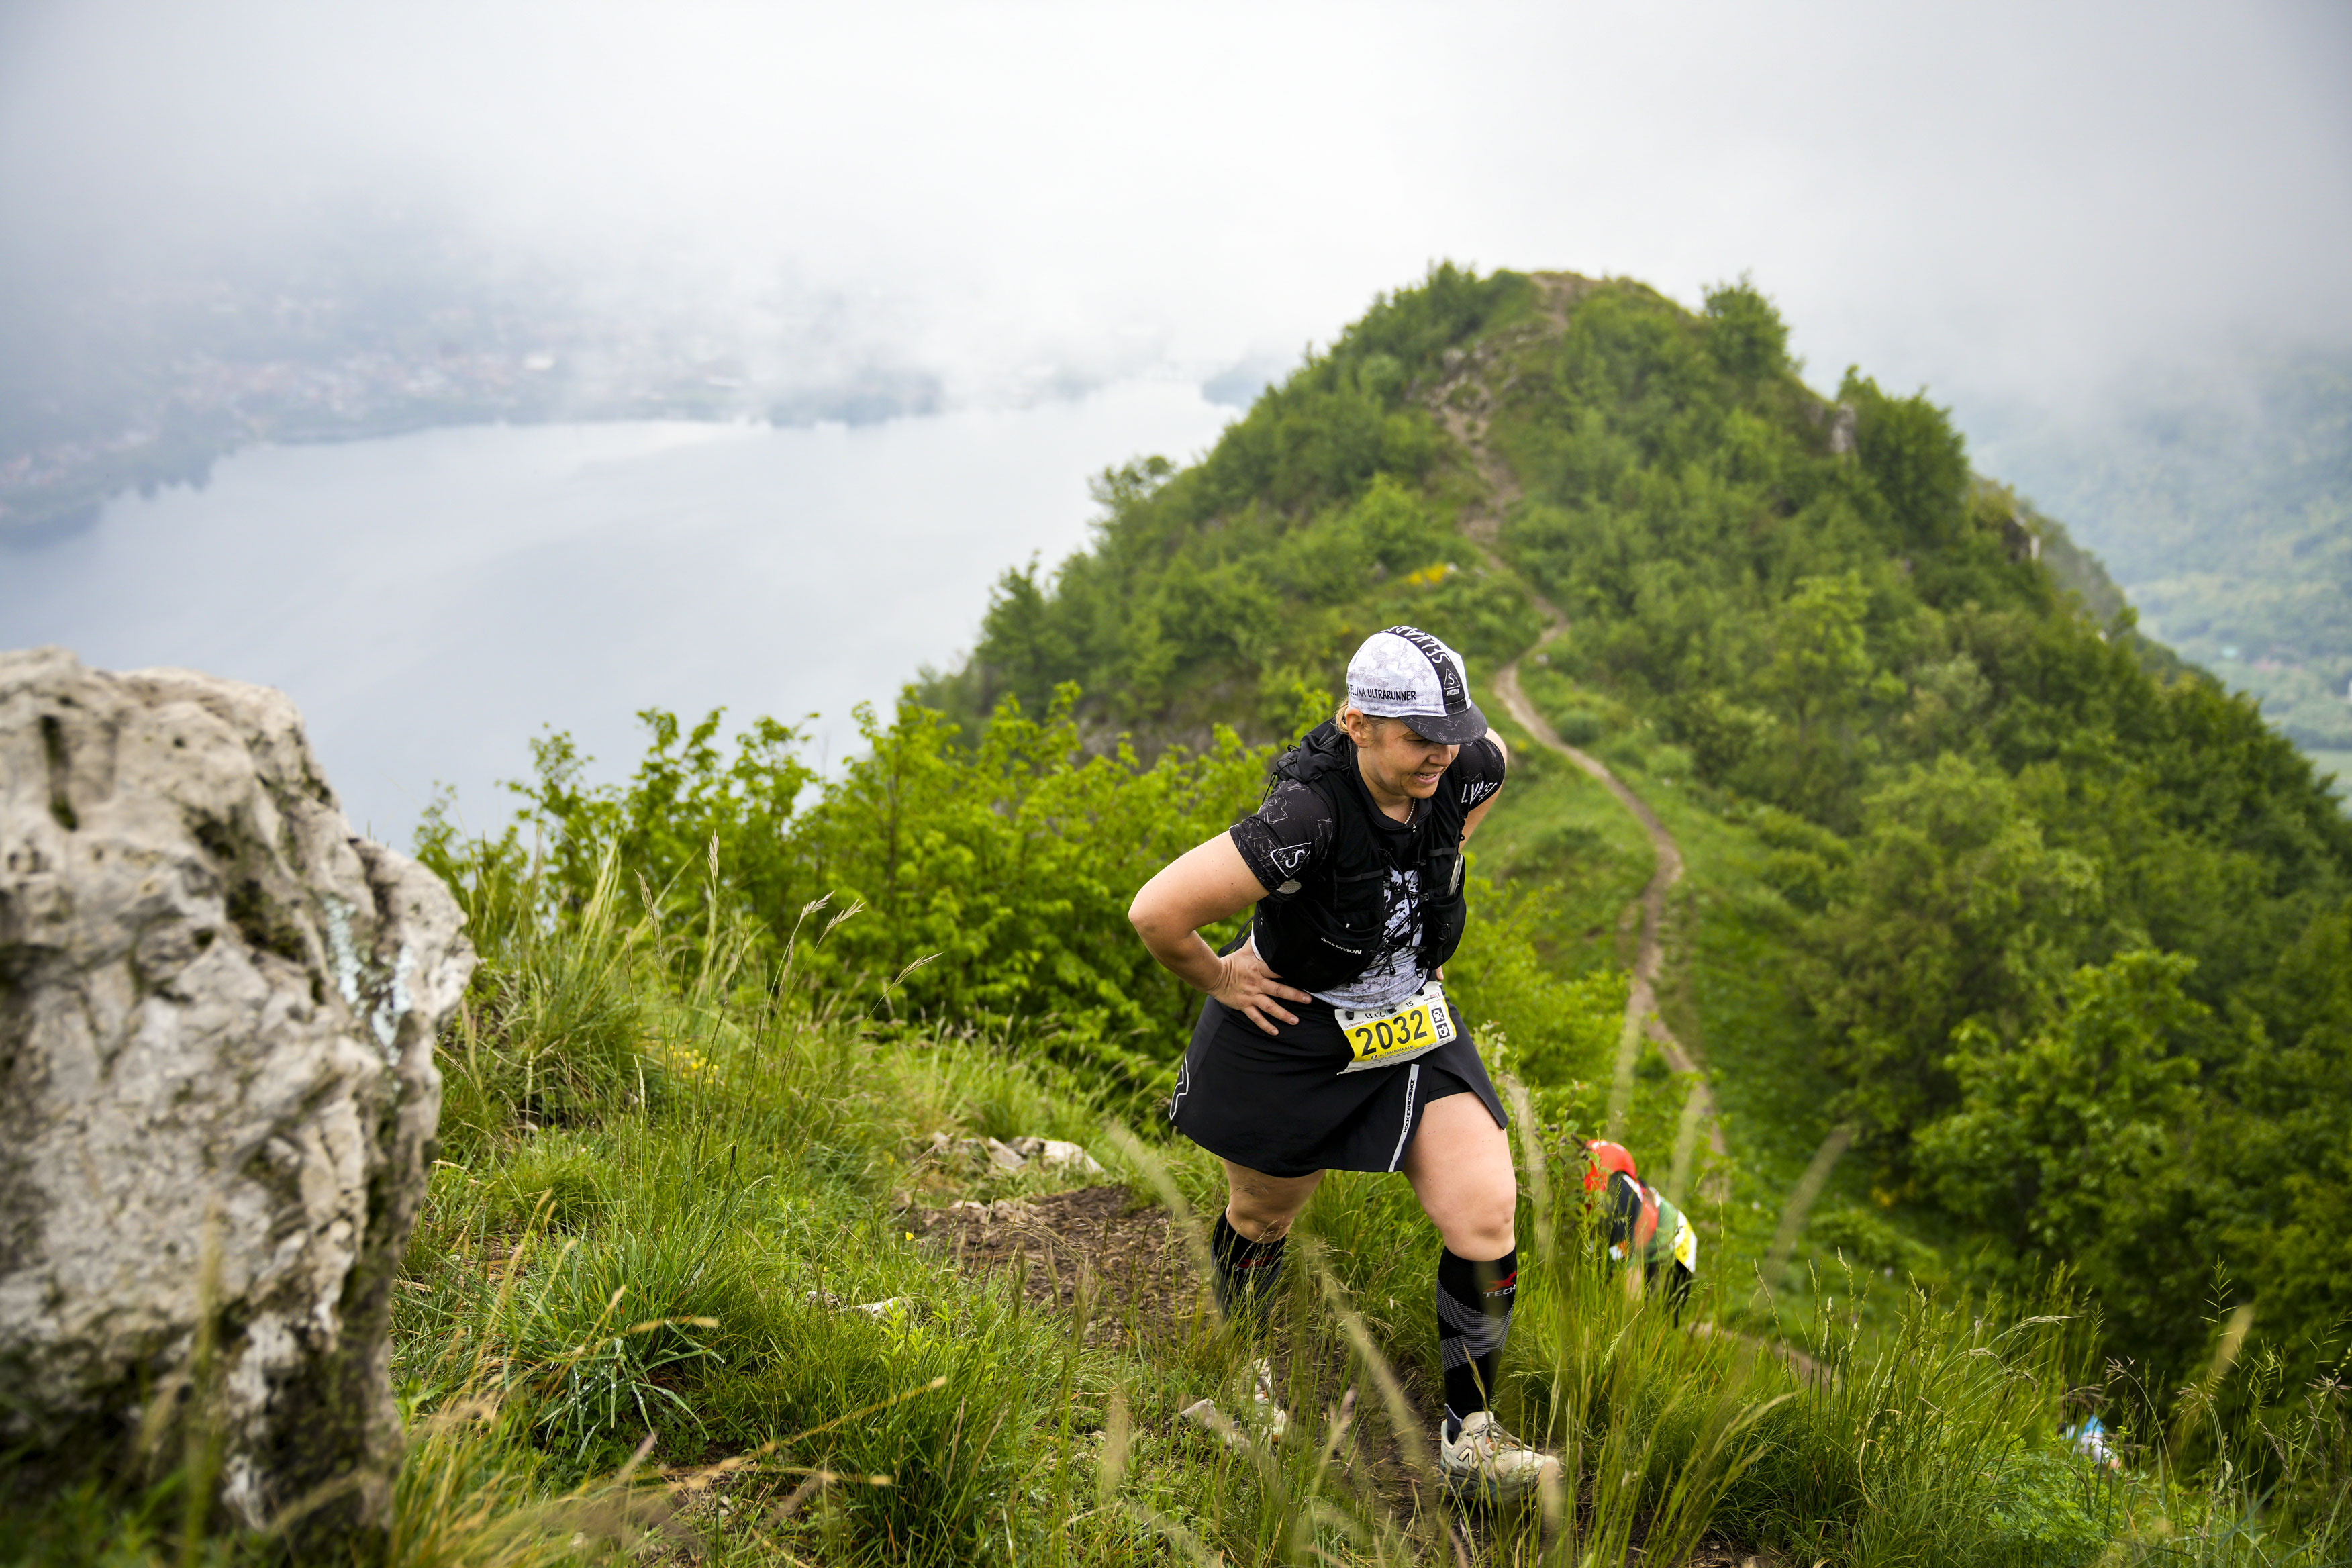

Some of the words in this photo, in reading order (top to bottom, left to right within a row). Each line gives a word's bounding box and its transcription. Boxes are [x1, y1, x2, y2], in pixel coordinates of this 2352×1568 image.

[1367, 688, 1416, 701] ULTRARUNNER
[1320, 937, 1362, 954] SALOMON
[1355, 1010, 1428, 1057] 2032
[1379, 1048, 1404, 1057] ALESSANDRA
[1407, 1079, 1415, 1116] EXPERIENCE
[1482, 1283, 1516, 1298] TECH
